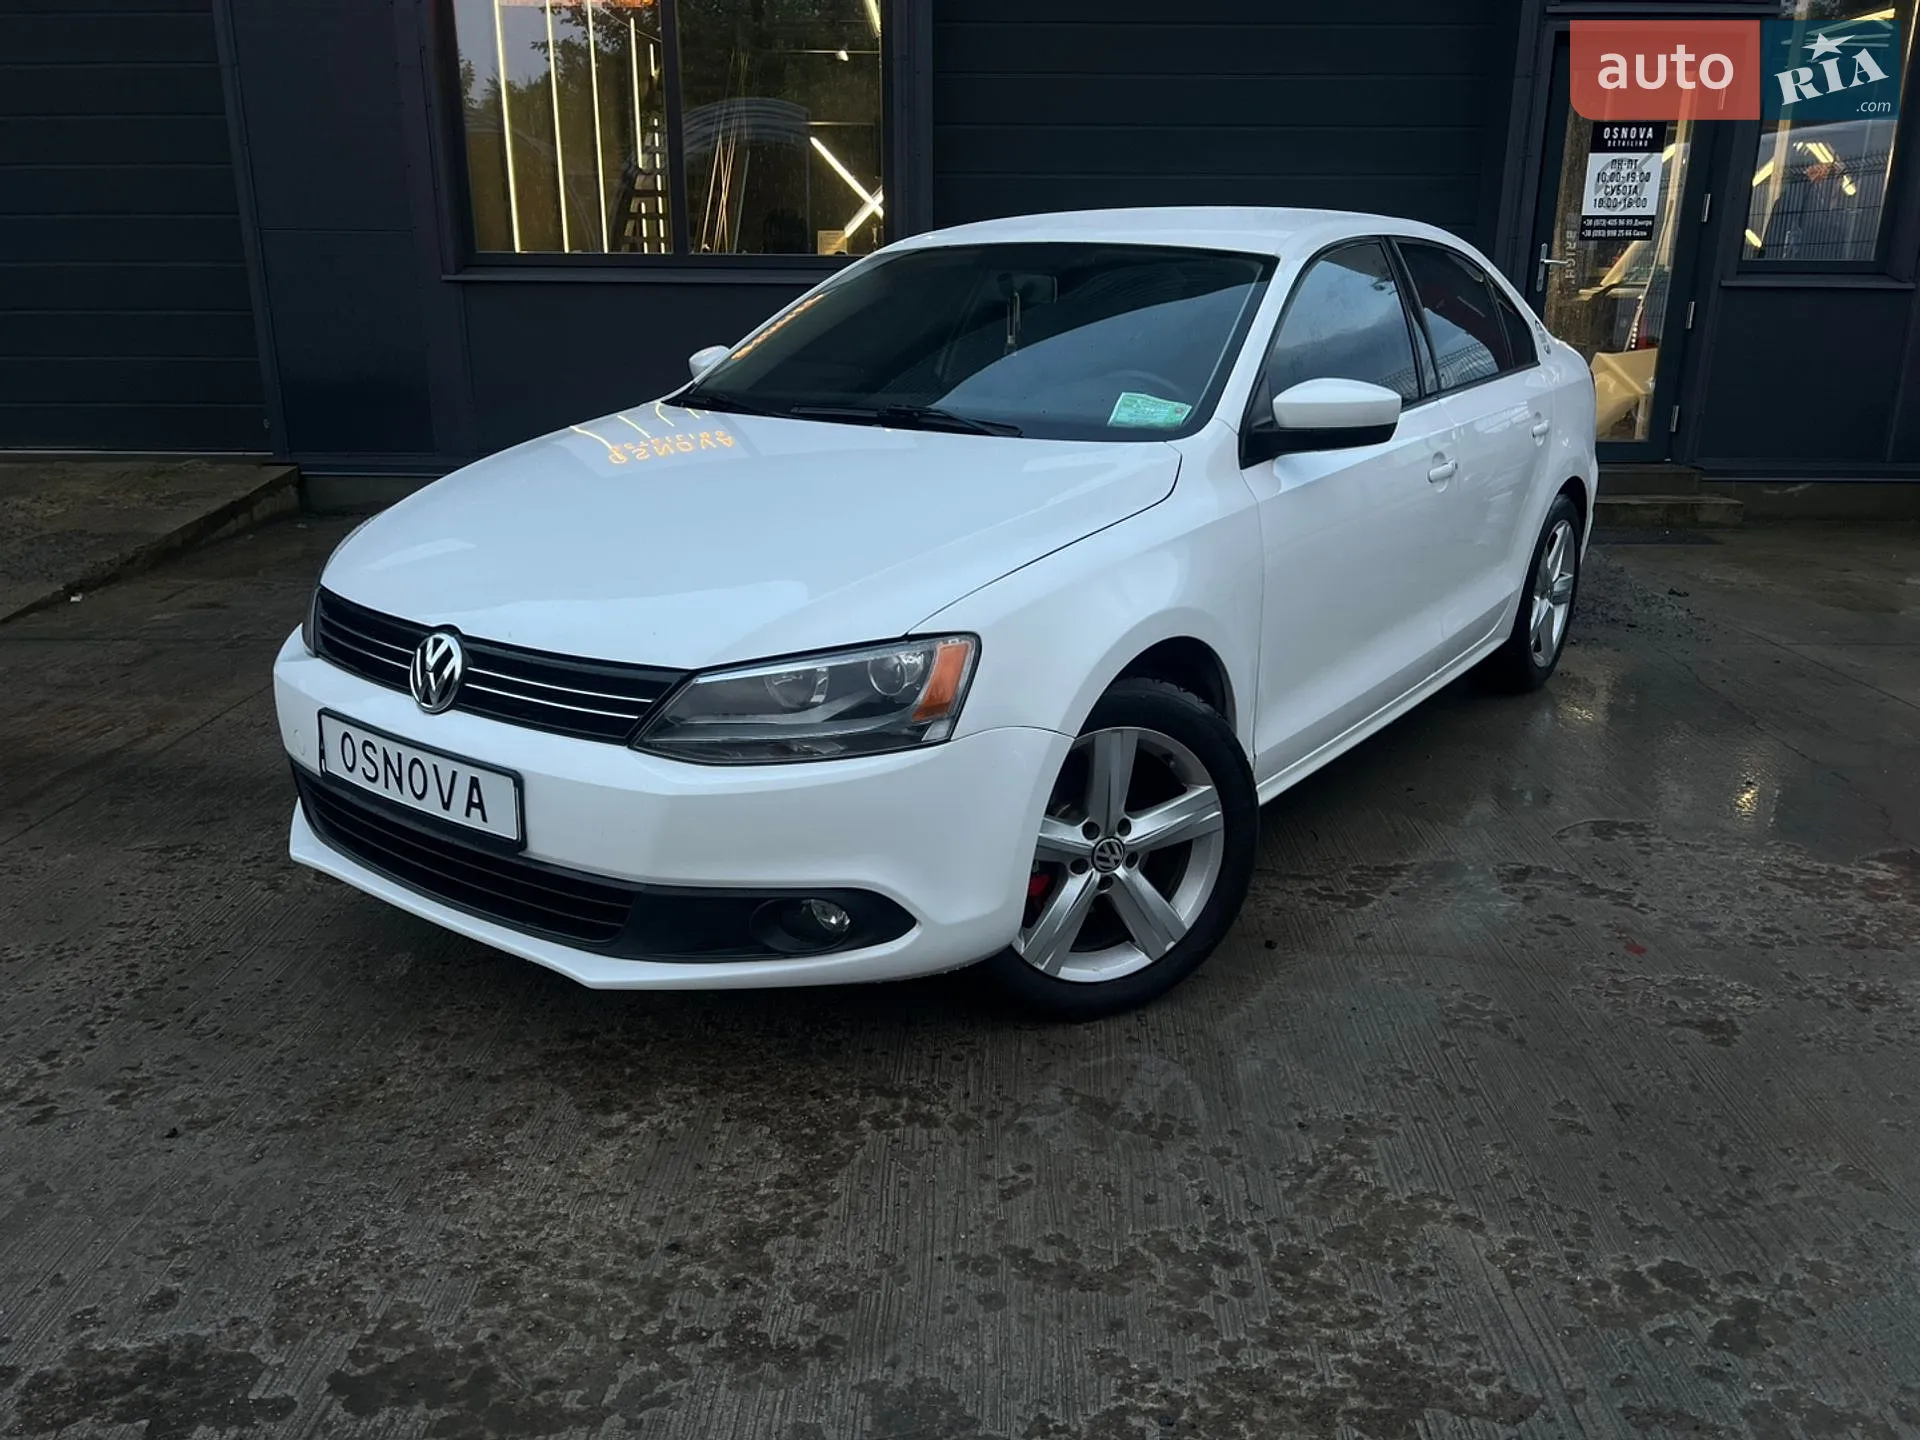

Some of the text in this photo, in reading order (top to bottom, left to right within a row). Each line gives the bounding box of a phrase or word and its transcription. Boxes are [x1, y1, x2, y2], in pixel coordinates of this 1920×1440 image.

[1603, 127, 1653, 139] OSNOVA
[1604, 185, 1638, 196] СУБОТА
[341, 731, 488, 823] OSNOVA
